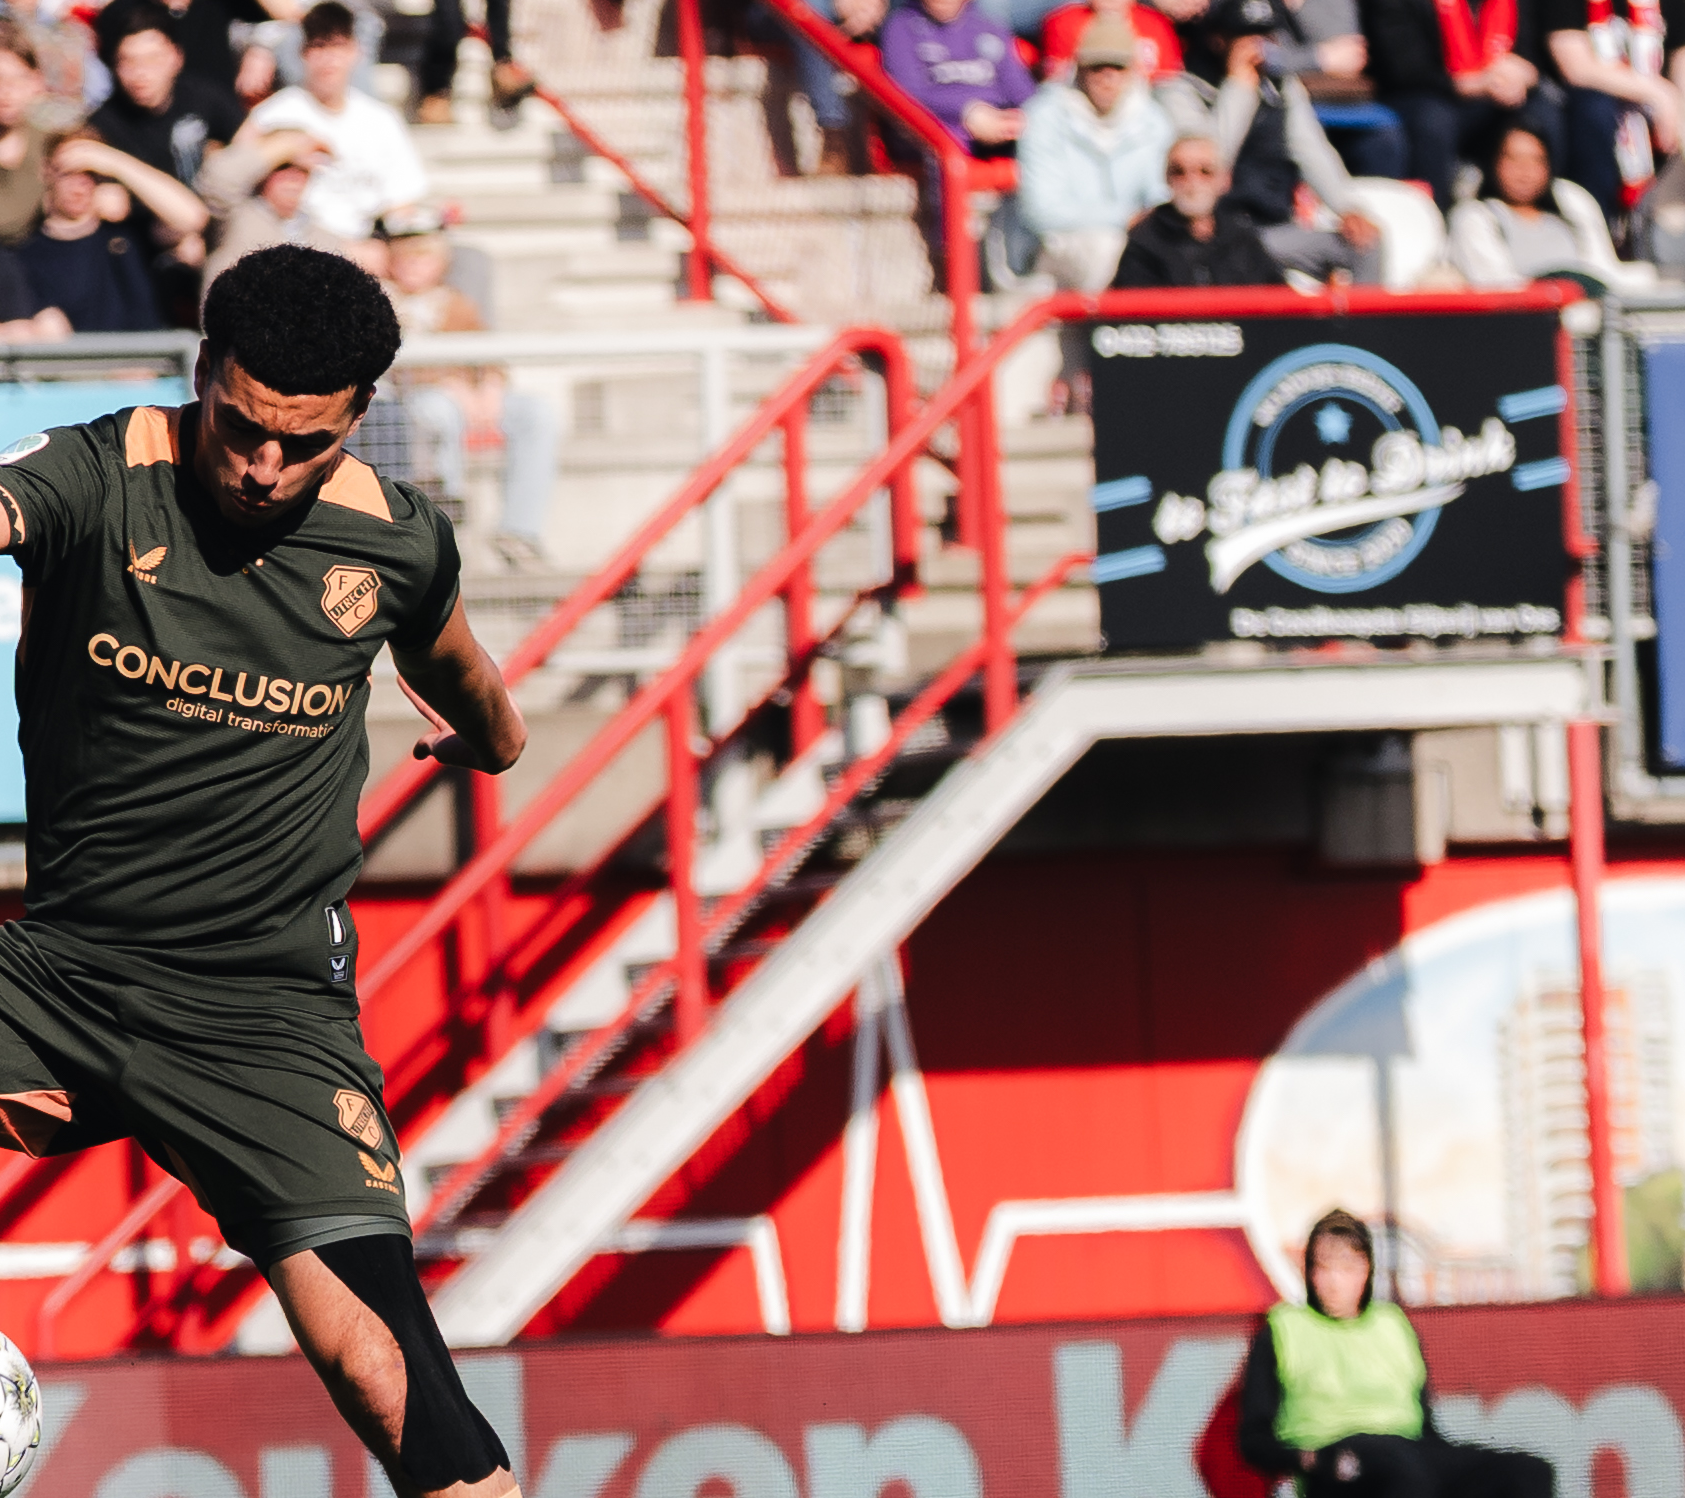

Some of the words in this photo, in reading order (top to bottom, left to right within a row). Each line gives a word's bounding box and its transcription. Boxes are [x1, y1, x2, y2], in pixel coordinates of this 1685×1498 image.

[338, 574, 348, 591] F
[329, 575, 376, 619] UTRECHT
[353, 604, 366, 620] C
[88, 633, 354, 716] CONCLUSION
[166, 697, 223, 723] digital
